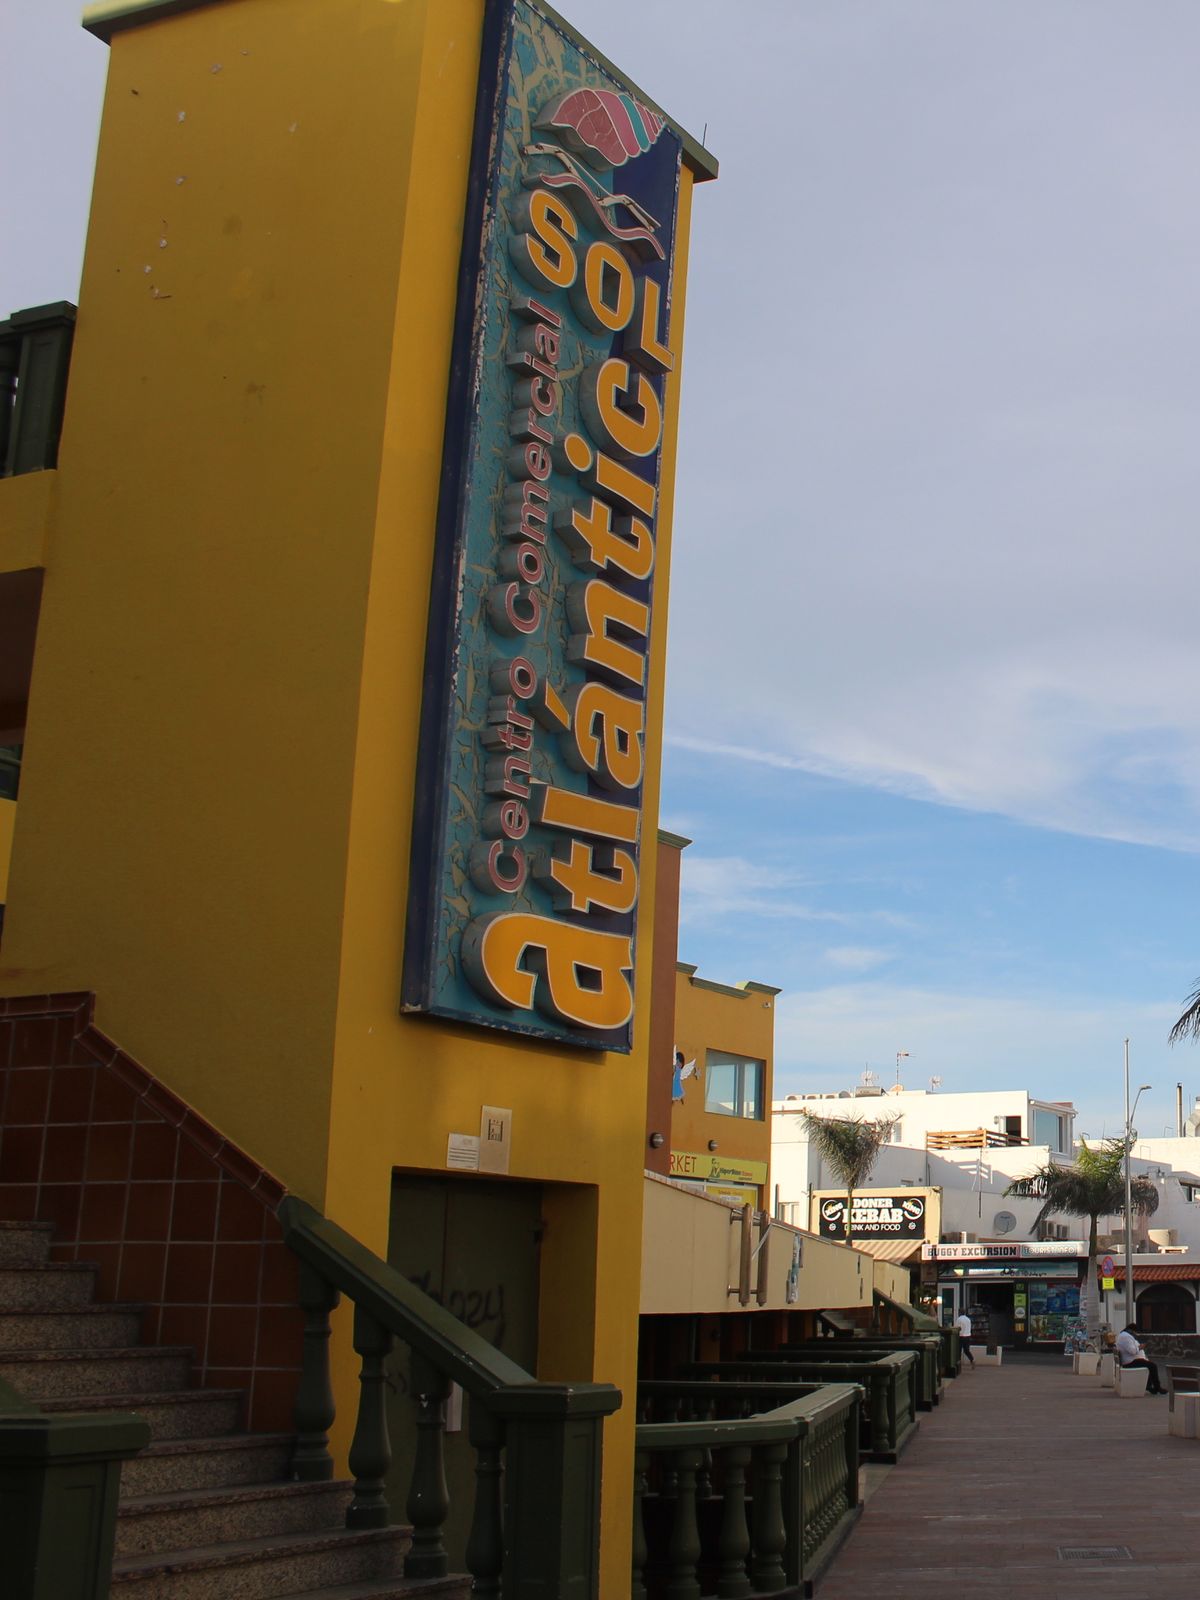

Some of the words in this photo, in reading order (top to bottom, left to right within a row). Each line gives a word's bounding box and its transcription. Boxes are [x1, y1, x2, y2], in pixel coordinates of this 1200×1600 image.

[505, 297, 562, 635] Comercial
[488, 656, 537, 894] Centro
[825, 1202, 844, 1217] KING
[852, 1198, 893, 1208] DONER
[902, 1200, 921, 1215] KING
[841, 1208, 904, 1223] KEBAB
[864, 1223, 880, 1231] AND
[880, 1223, 901, 1231] FOOD
[927, 1247, 958, 1257] BUGGY
[961, 1246, 1017, 1256] EXCURSION
